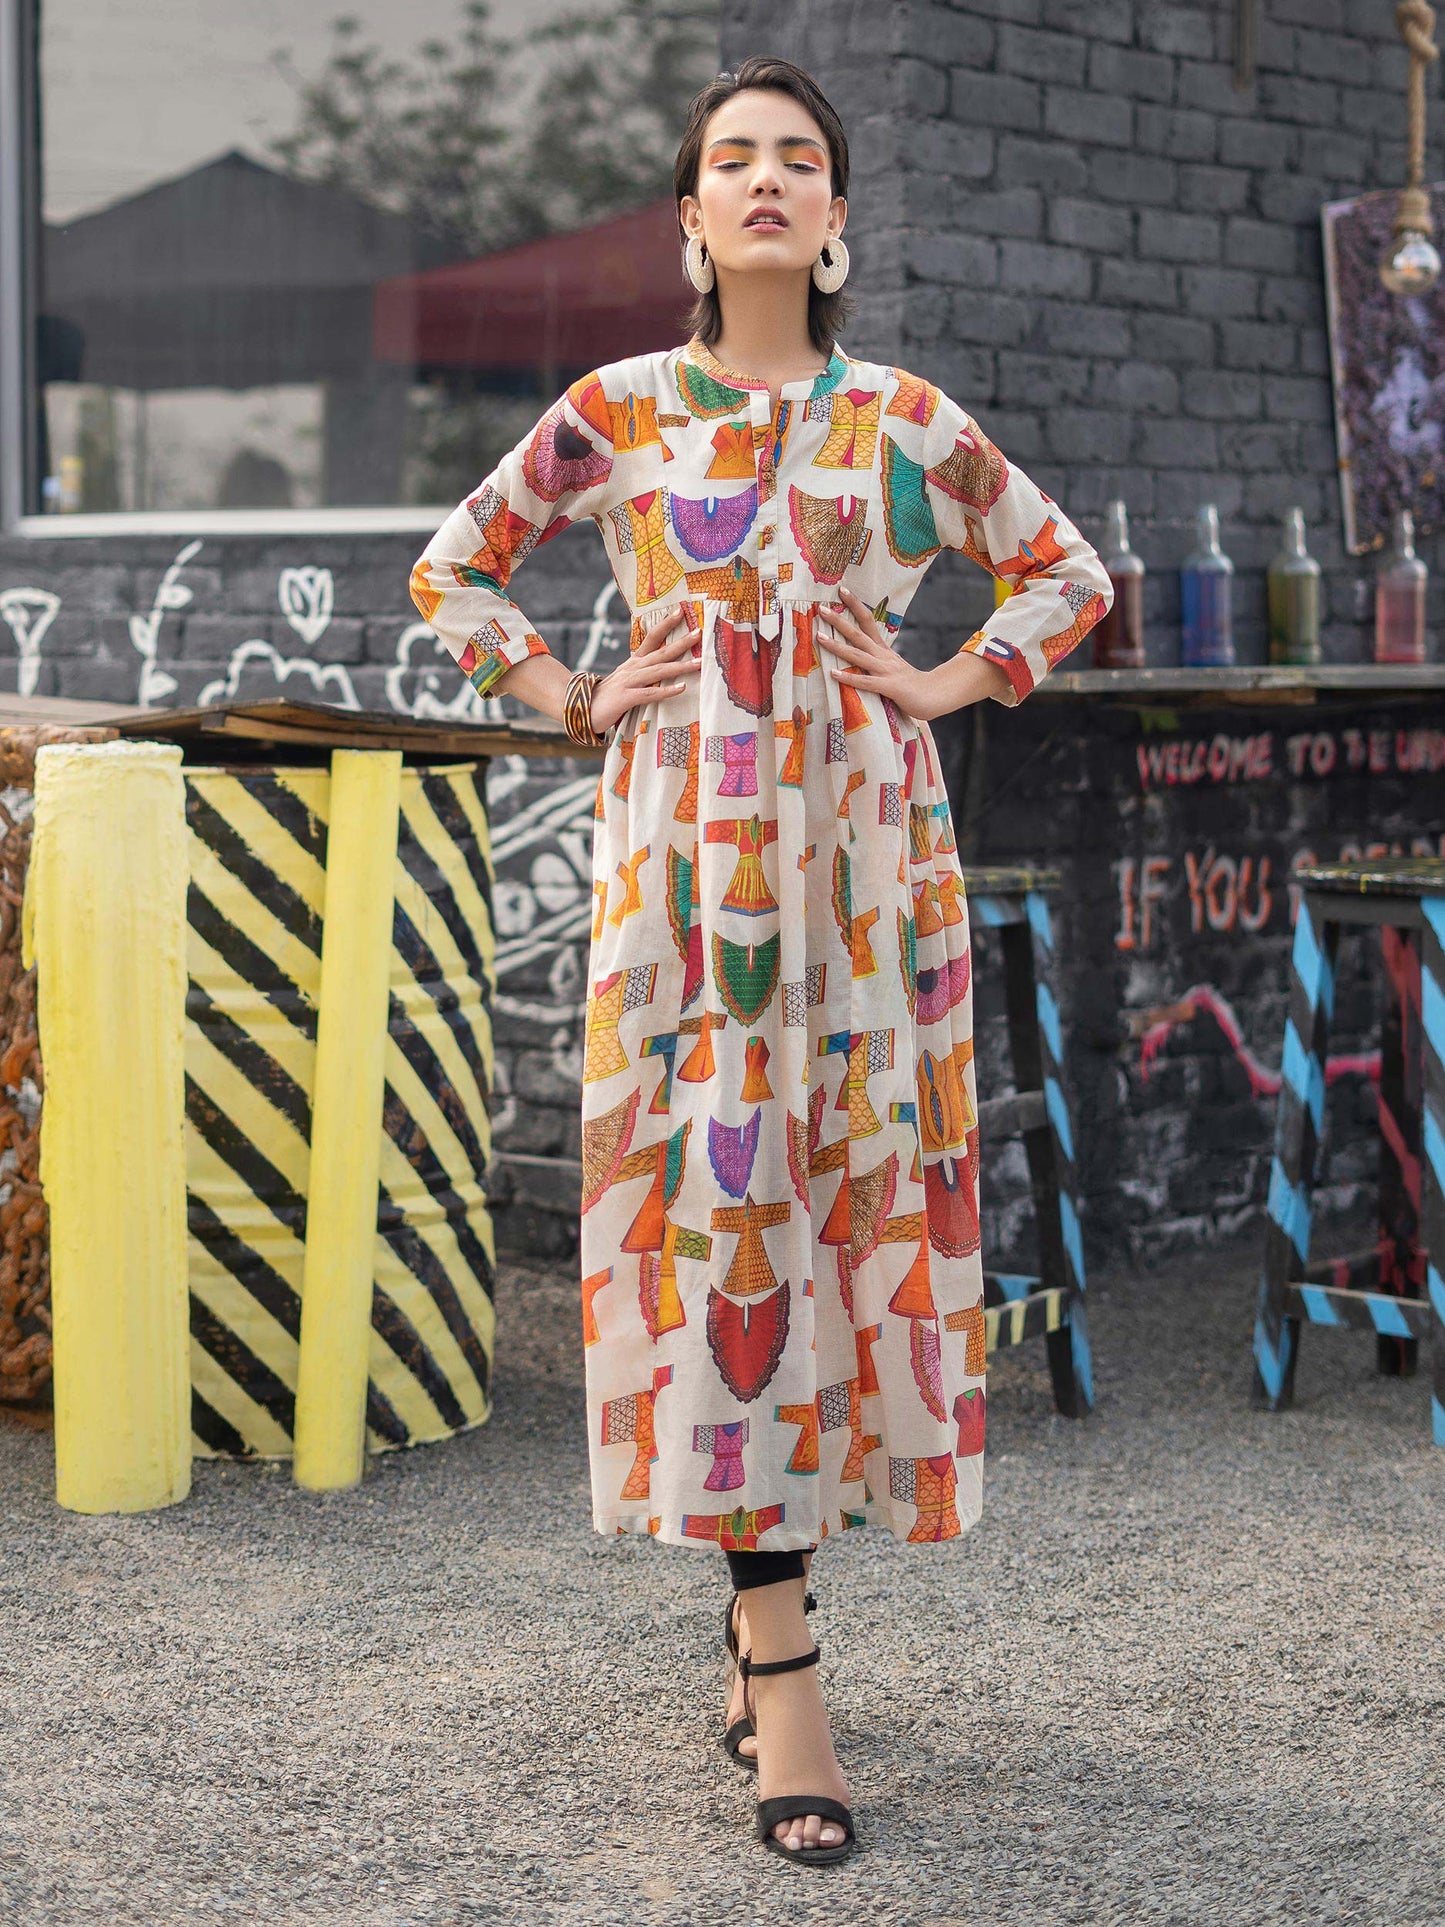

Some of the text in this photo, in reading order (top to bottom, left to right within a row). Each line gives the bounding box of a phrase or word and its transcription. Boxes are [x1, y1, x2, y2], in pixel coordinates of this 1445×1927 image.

[1136, 732, 1273, 790] WELCOME
[1286, 731, 1336, 776] TO
[1112, 856, 1172, 950] IF
[1185, 847, 1272, 933] YOU
